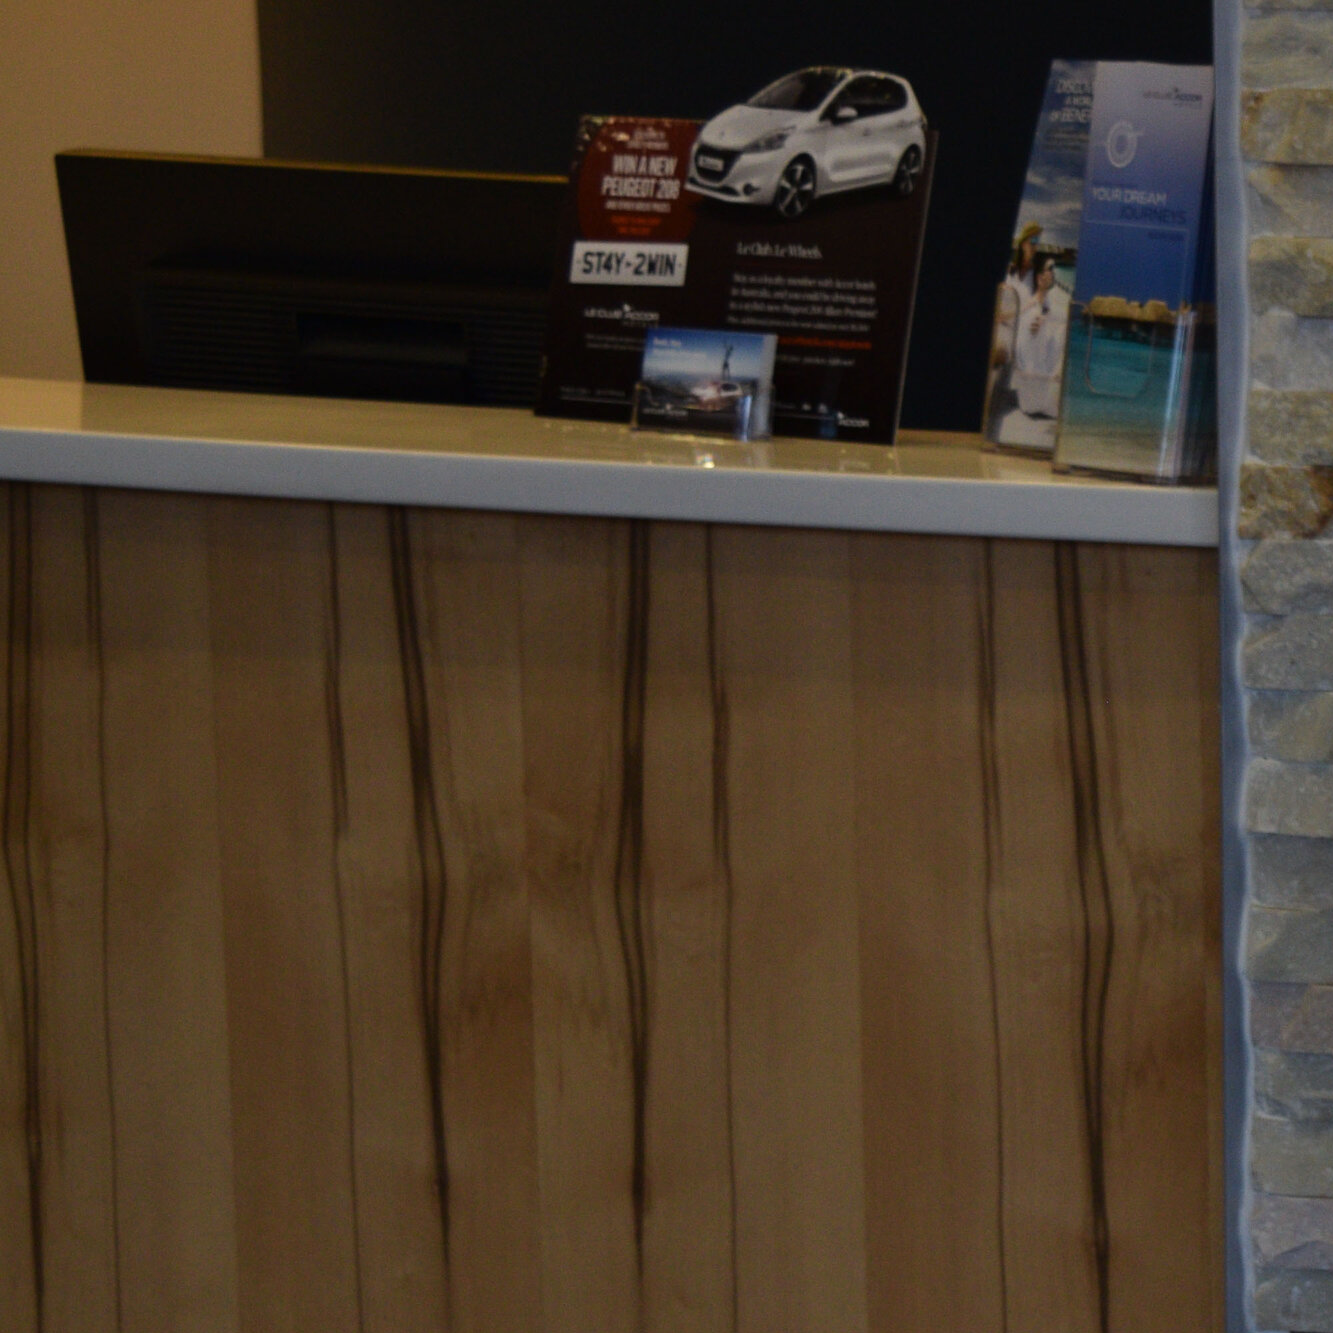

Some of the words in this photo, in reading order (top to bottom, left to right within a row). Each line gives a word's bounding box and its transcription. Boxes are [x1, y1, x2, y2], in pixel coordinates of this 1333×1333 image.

[613, 155, 638, 174] WIN
[648, 157, 678, 177] NEW
[602, 176, 656, 198] PEUGEOT
